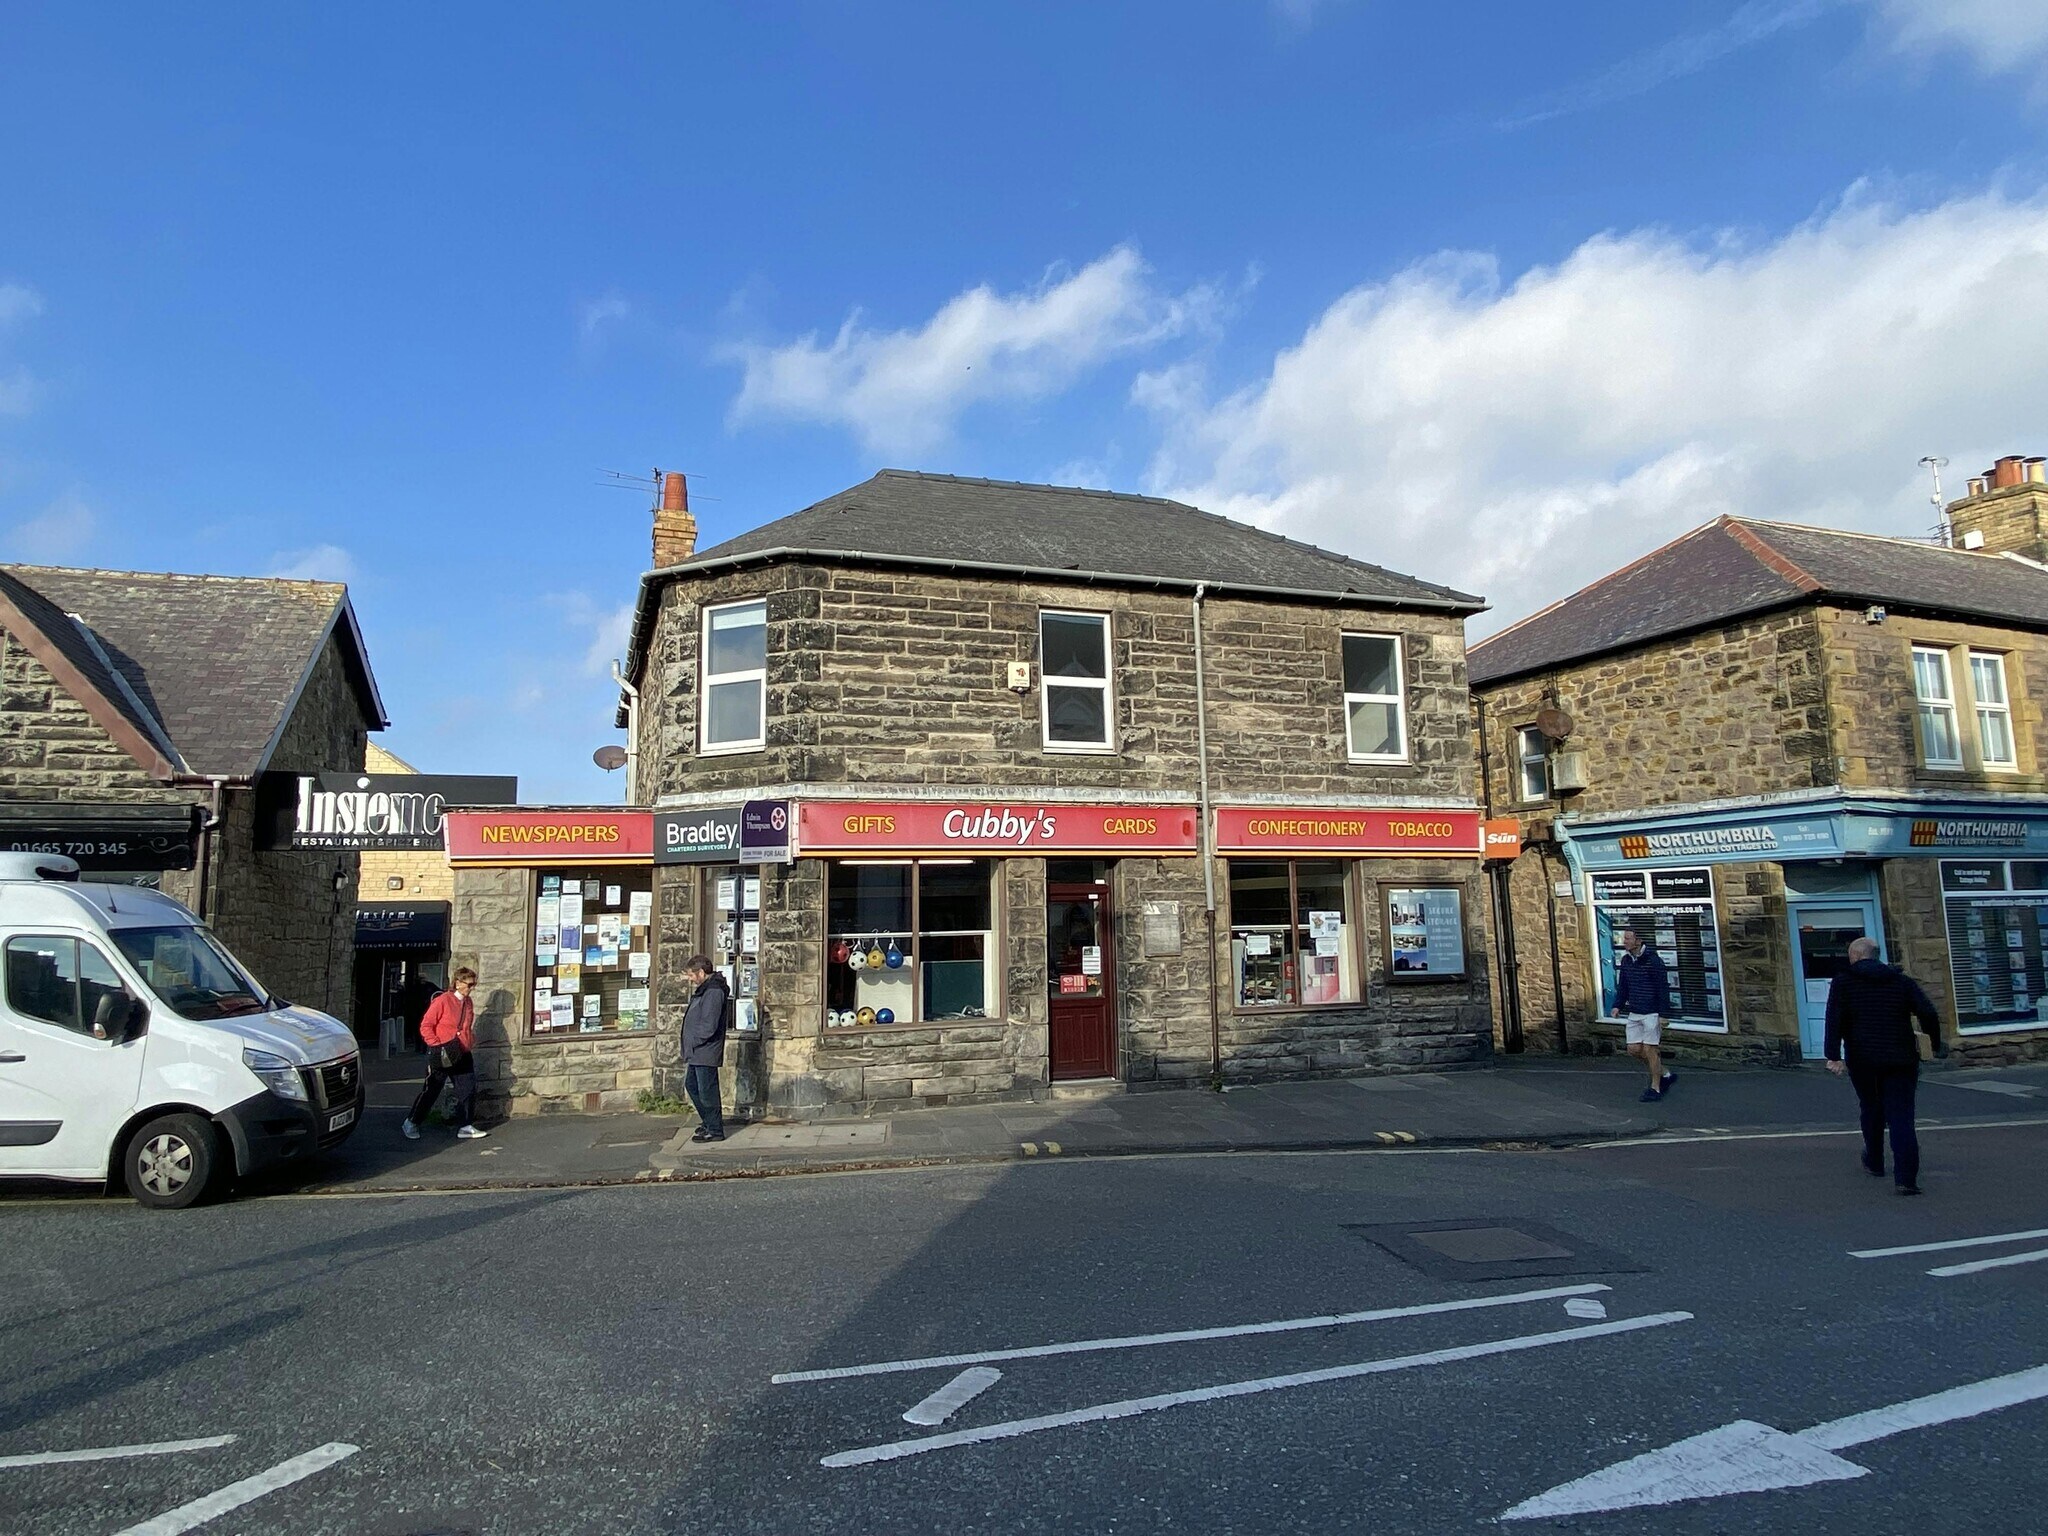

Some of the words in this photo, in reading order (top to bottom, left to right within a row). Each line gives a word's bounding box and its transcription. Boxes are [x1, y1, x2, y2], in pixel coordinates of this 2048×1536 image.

[295, 776, 446, 836] Insieme
[843, 815, 896, 834] GIFTS
[942, 808, 1057, 845] Cubby's
[1102, 818, 1158, 835] CARDS
[1248, 819, 1367, 837] CONFECTIONERY
[1387, 821, 1453, 838] TOBACCO
[1936, 821, 2028, 836] NORTHUMBRIA
[292, 837, 378, 847] RESTAURANT
[385, 837, 442, 847] PIZZERIA
[482, 825, 620, 843] NEWSPAPERS
[666, 819, 738, 850] Bradley
[1486, 832, 1518, 844] Sun
[1646, 825, 1776, 849] NORTHUMBRIA
[11, 842, 62, 854] 01665
[65, 842, 95, 854] 720
[98, 842, 127, 854] 345
[1650, 849, 1673, 857] COAST
[1682, 845, 1718, 855] COUNTRY
[1720, 841, 1762, 854] COTTAGES
[1763, 841, 1778, 849] LTD
